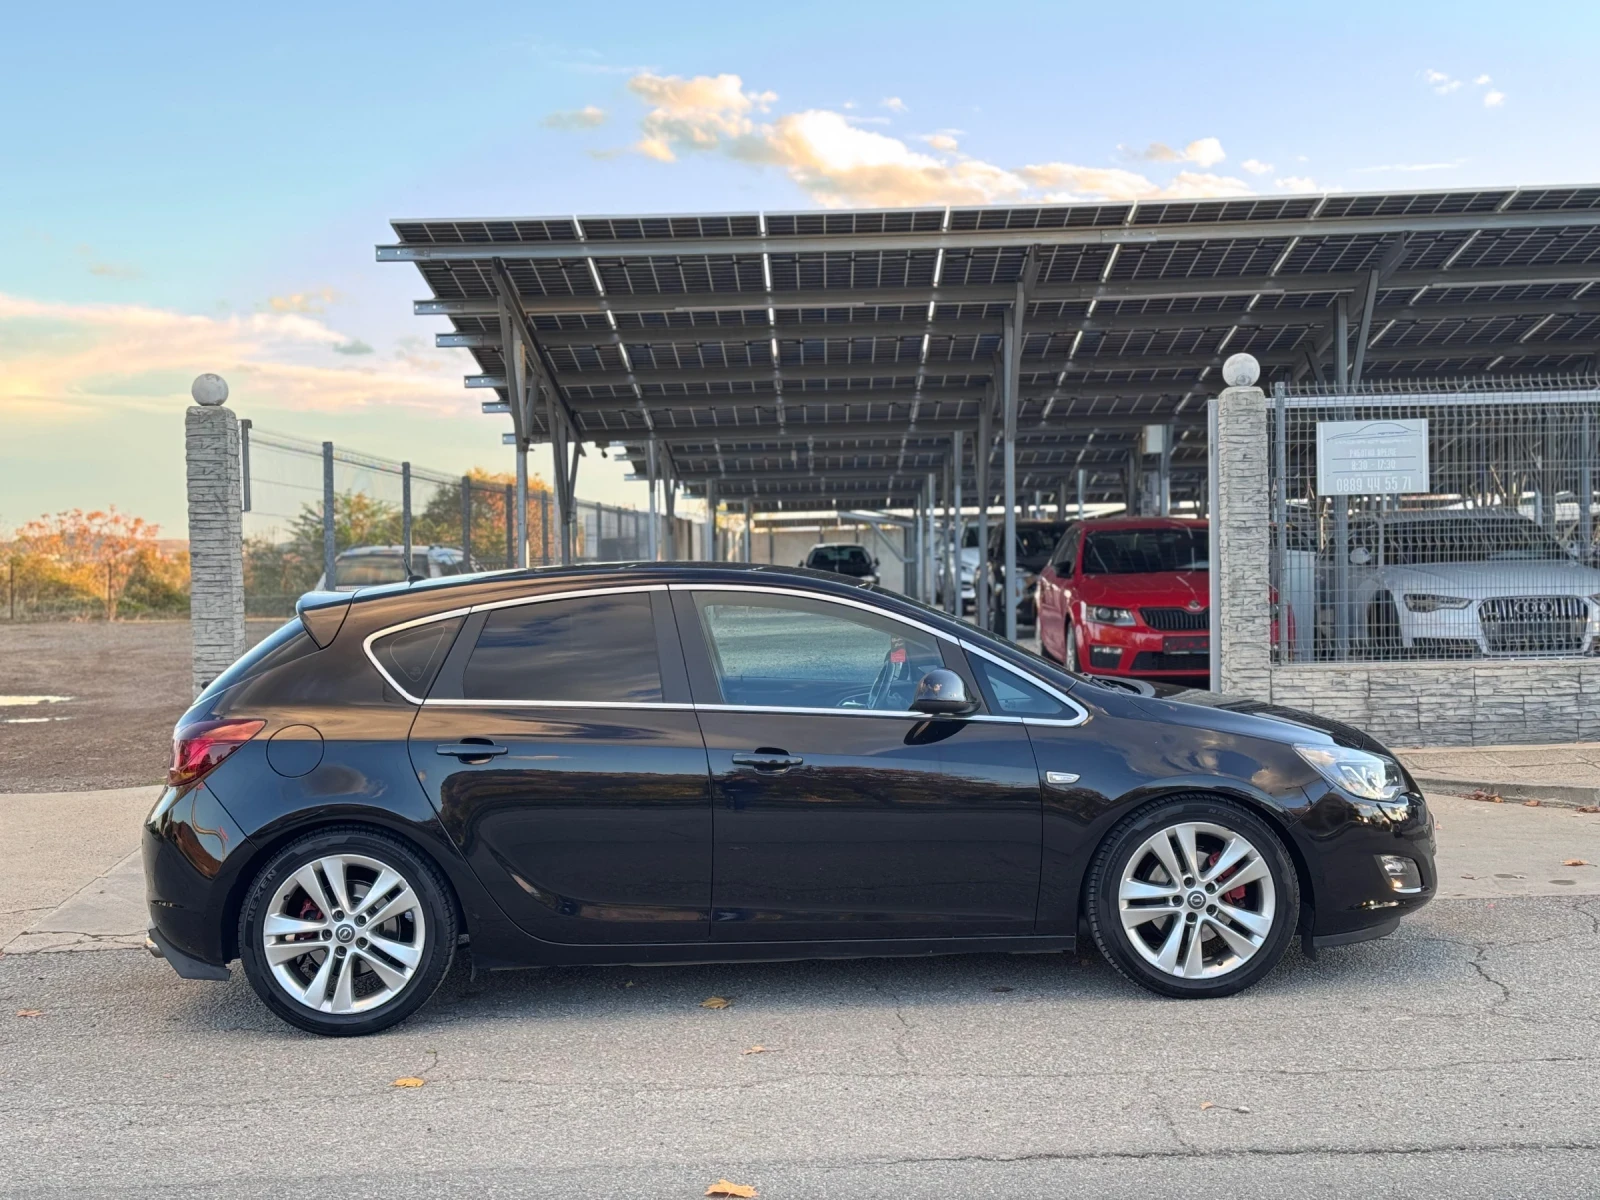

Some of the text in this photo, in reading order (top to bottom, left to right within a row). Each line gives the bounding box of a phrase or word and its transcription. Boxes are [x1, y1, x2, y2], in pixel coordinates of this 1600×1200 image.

[1351, 460, 1368, 470] 8:30
[1377, 459, 1396, 469] 17:30
[1336, 476, 1412, 492] 0889 44 55 71
[247, 869, 278, 922] NEXEN
